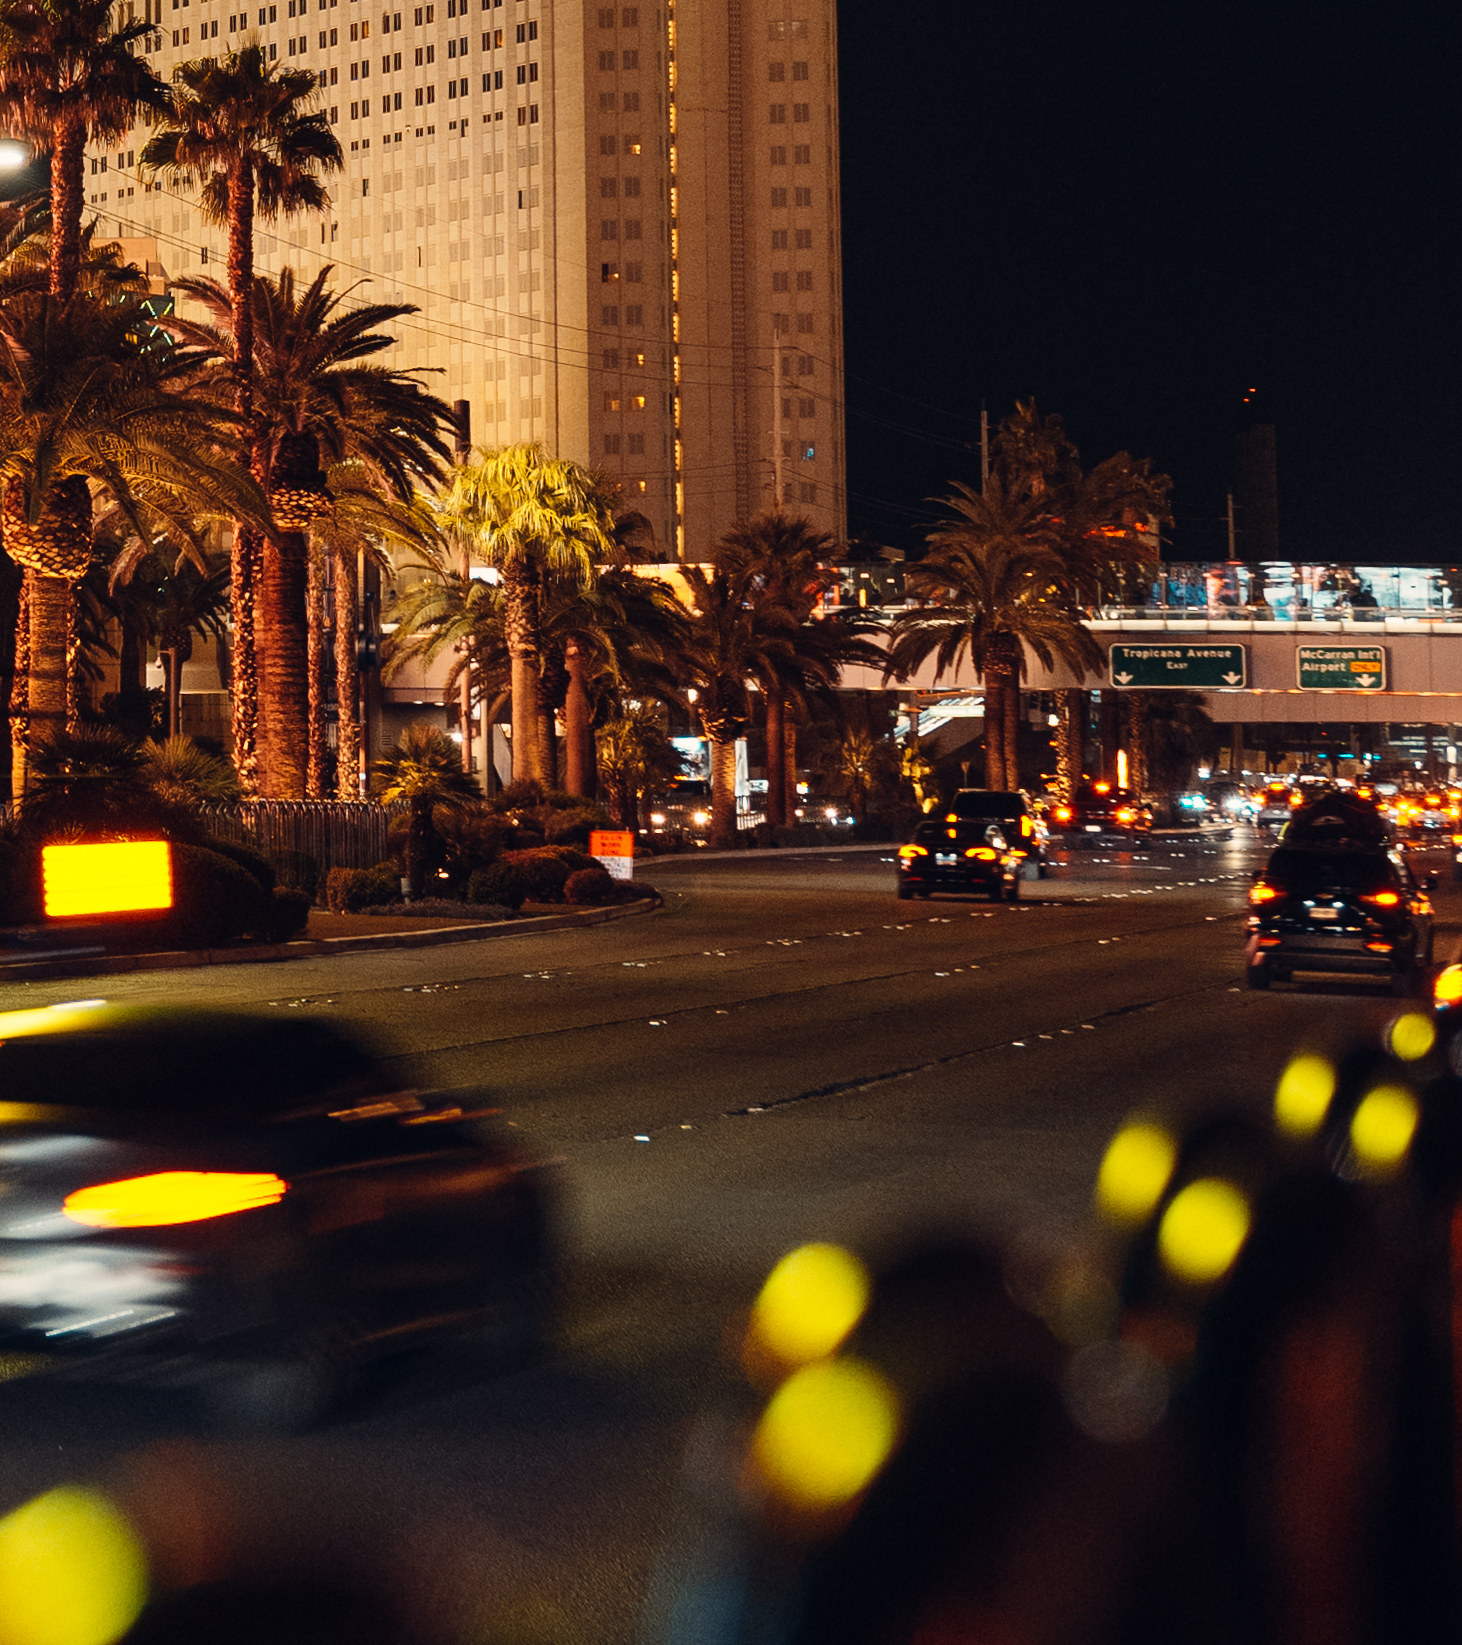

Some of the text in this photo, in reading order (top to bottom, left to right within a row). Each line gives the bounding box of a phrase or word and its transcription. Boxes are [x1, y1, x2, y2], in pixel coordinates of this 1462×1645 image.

[1122, 648, 1233, 660] Tropicana Avenue
[1300, 650, 1356, 660] McCarran
[1301, 662, 1347, 673] Airport
